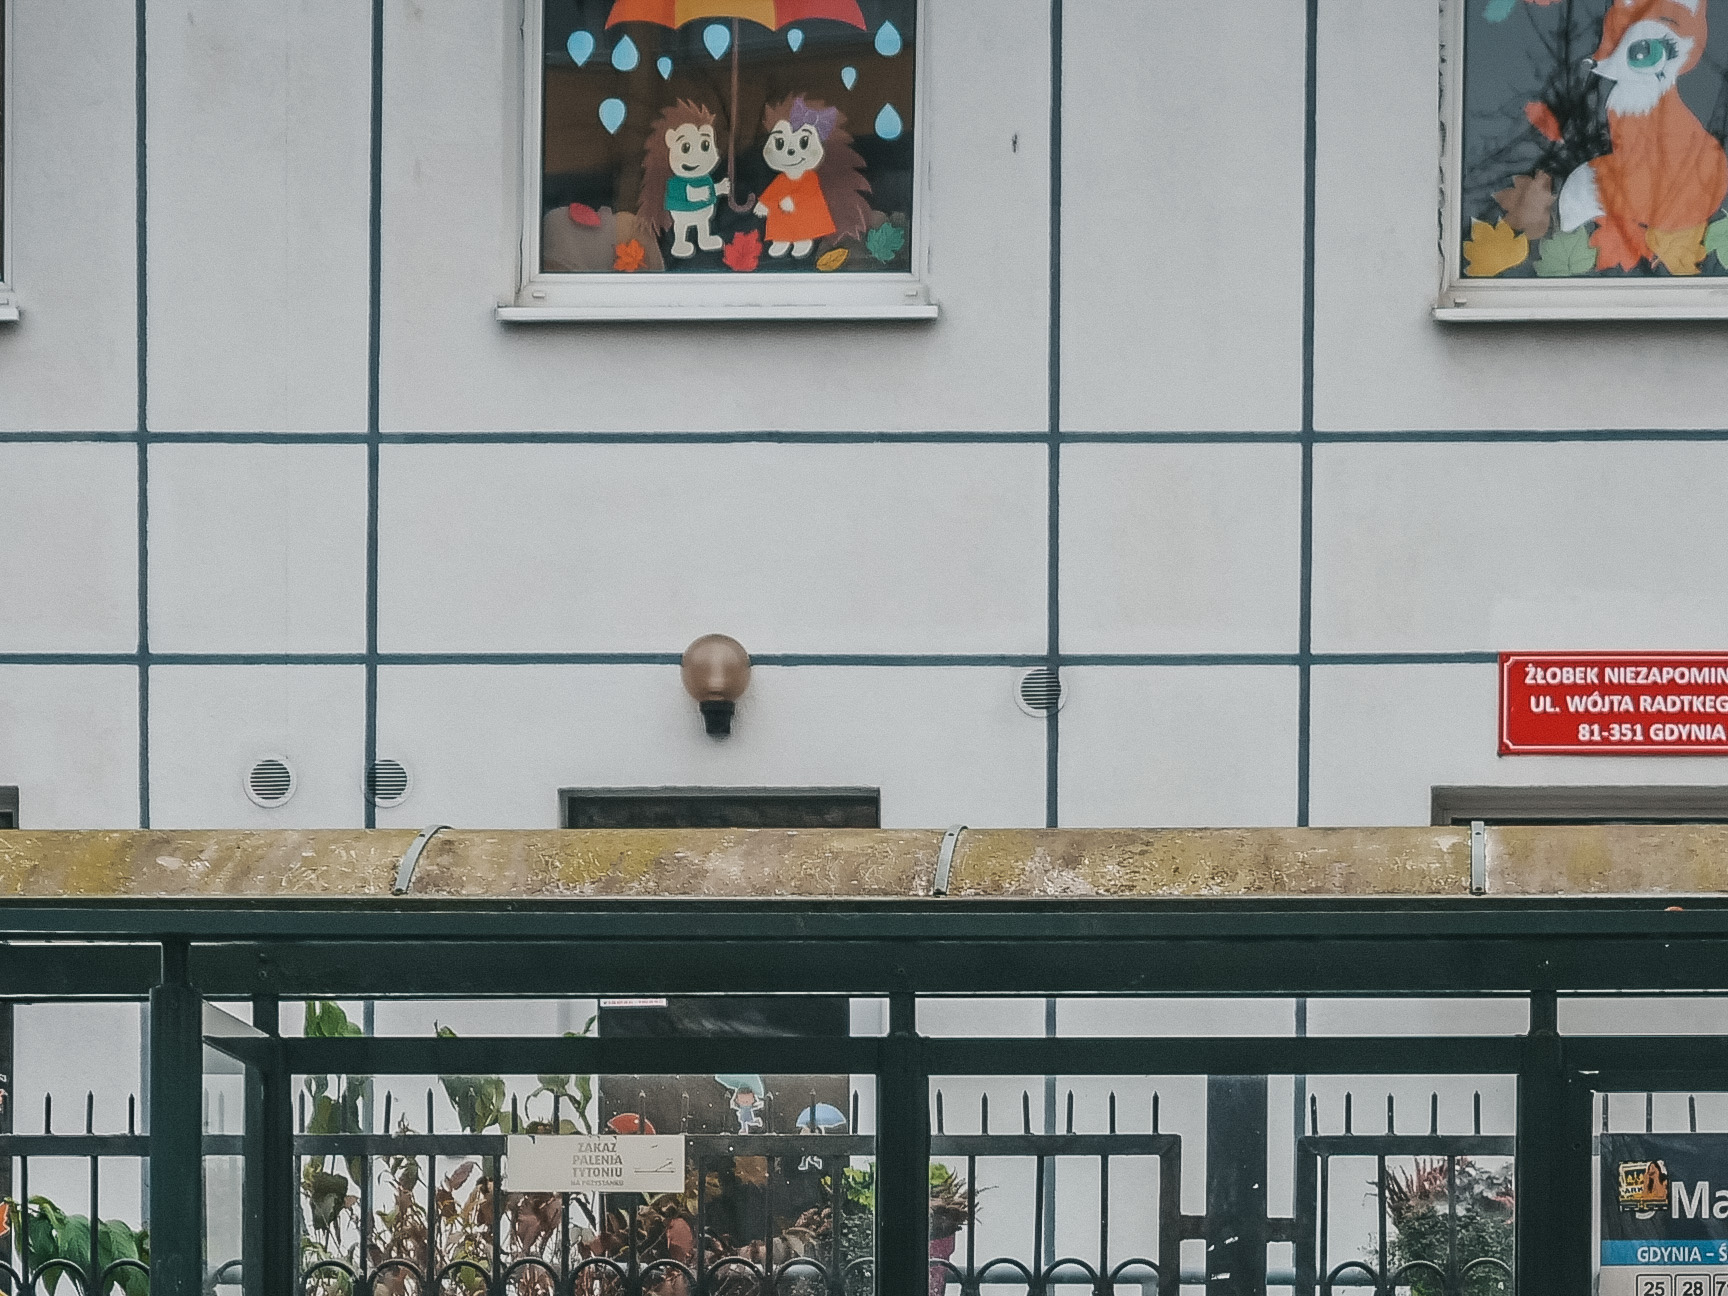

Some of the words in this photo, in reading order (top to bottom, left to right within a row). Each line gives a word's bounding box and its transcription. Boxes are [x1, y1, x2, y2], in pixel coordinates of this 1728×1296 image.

[1524, 663, 1598, 685] ŻŁOBEK
[1530, 695, 1560, 713] UL.
[1566, 691, 1635, 713] WÓJTA
[1578, 723, 1644, 741] 81-351
[1649, 723, 1727, 741] GDYNIA
[578, 1142, 617, 1153] ZAKAZ
[572, 1155, 623, 1165] PALENIA
[572, 1167, 623, 1177] TYTONIU
[1636, 1245, 1702, 1262] GDYNIA
[1682, 1281, 1704, 1296] 28
